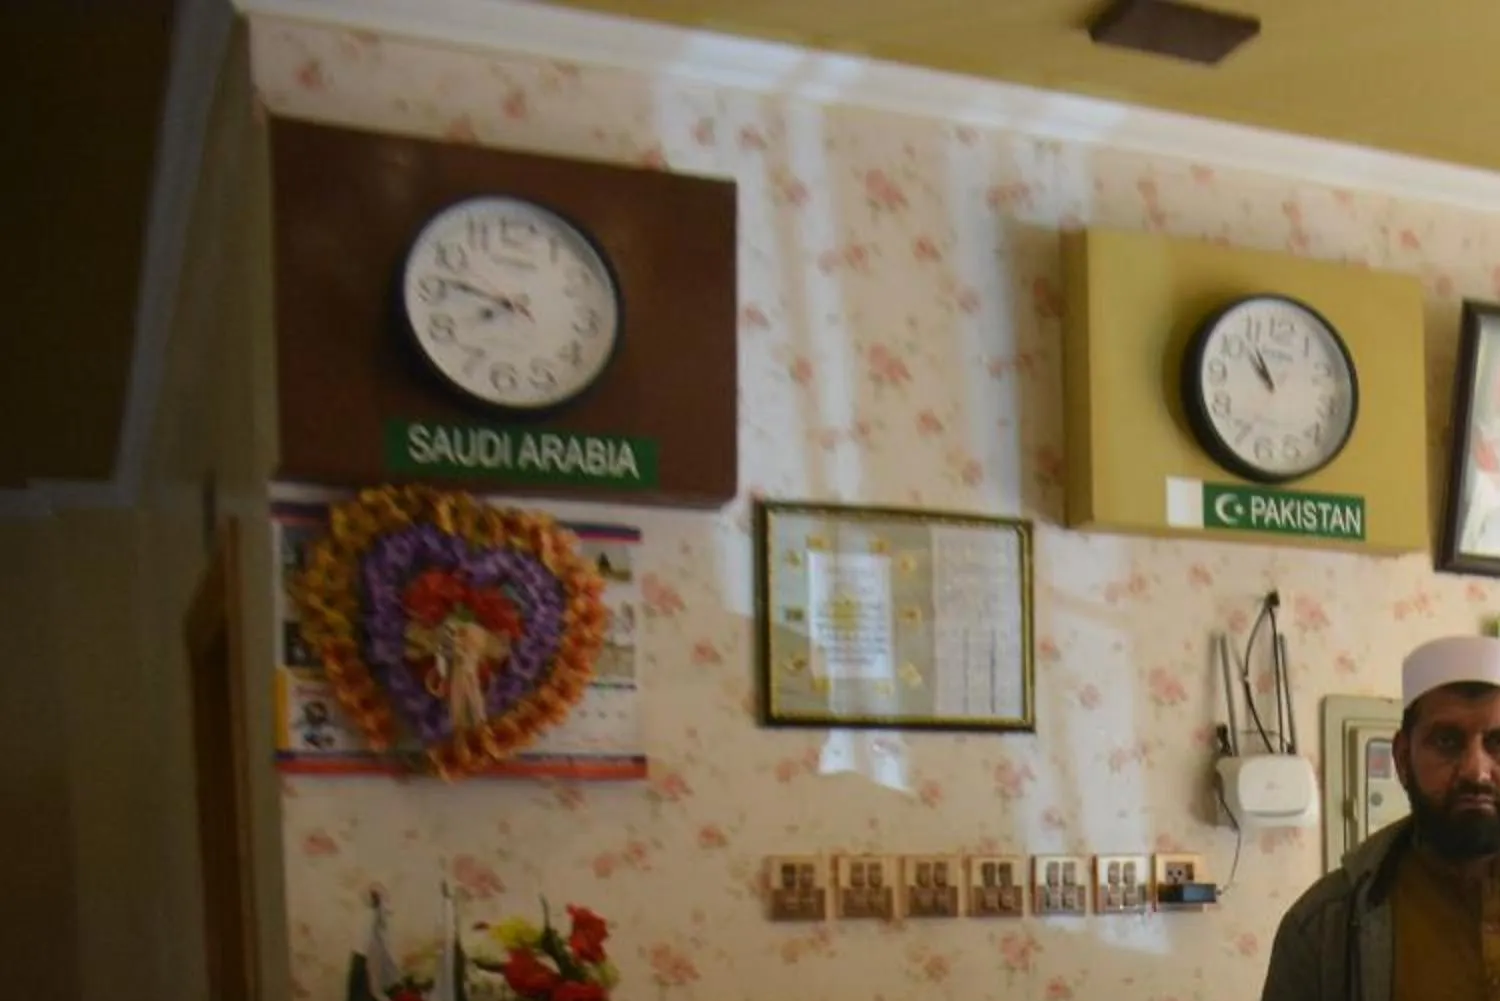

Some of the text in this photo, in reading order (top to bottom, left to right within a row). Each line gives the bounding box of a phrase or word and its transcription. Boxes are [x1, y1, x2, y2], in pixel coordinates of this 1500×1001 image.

[407, 423, 641, 480] SAUDI ARABIA
[1250, 494, 1362, 535] PAKISTAN
